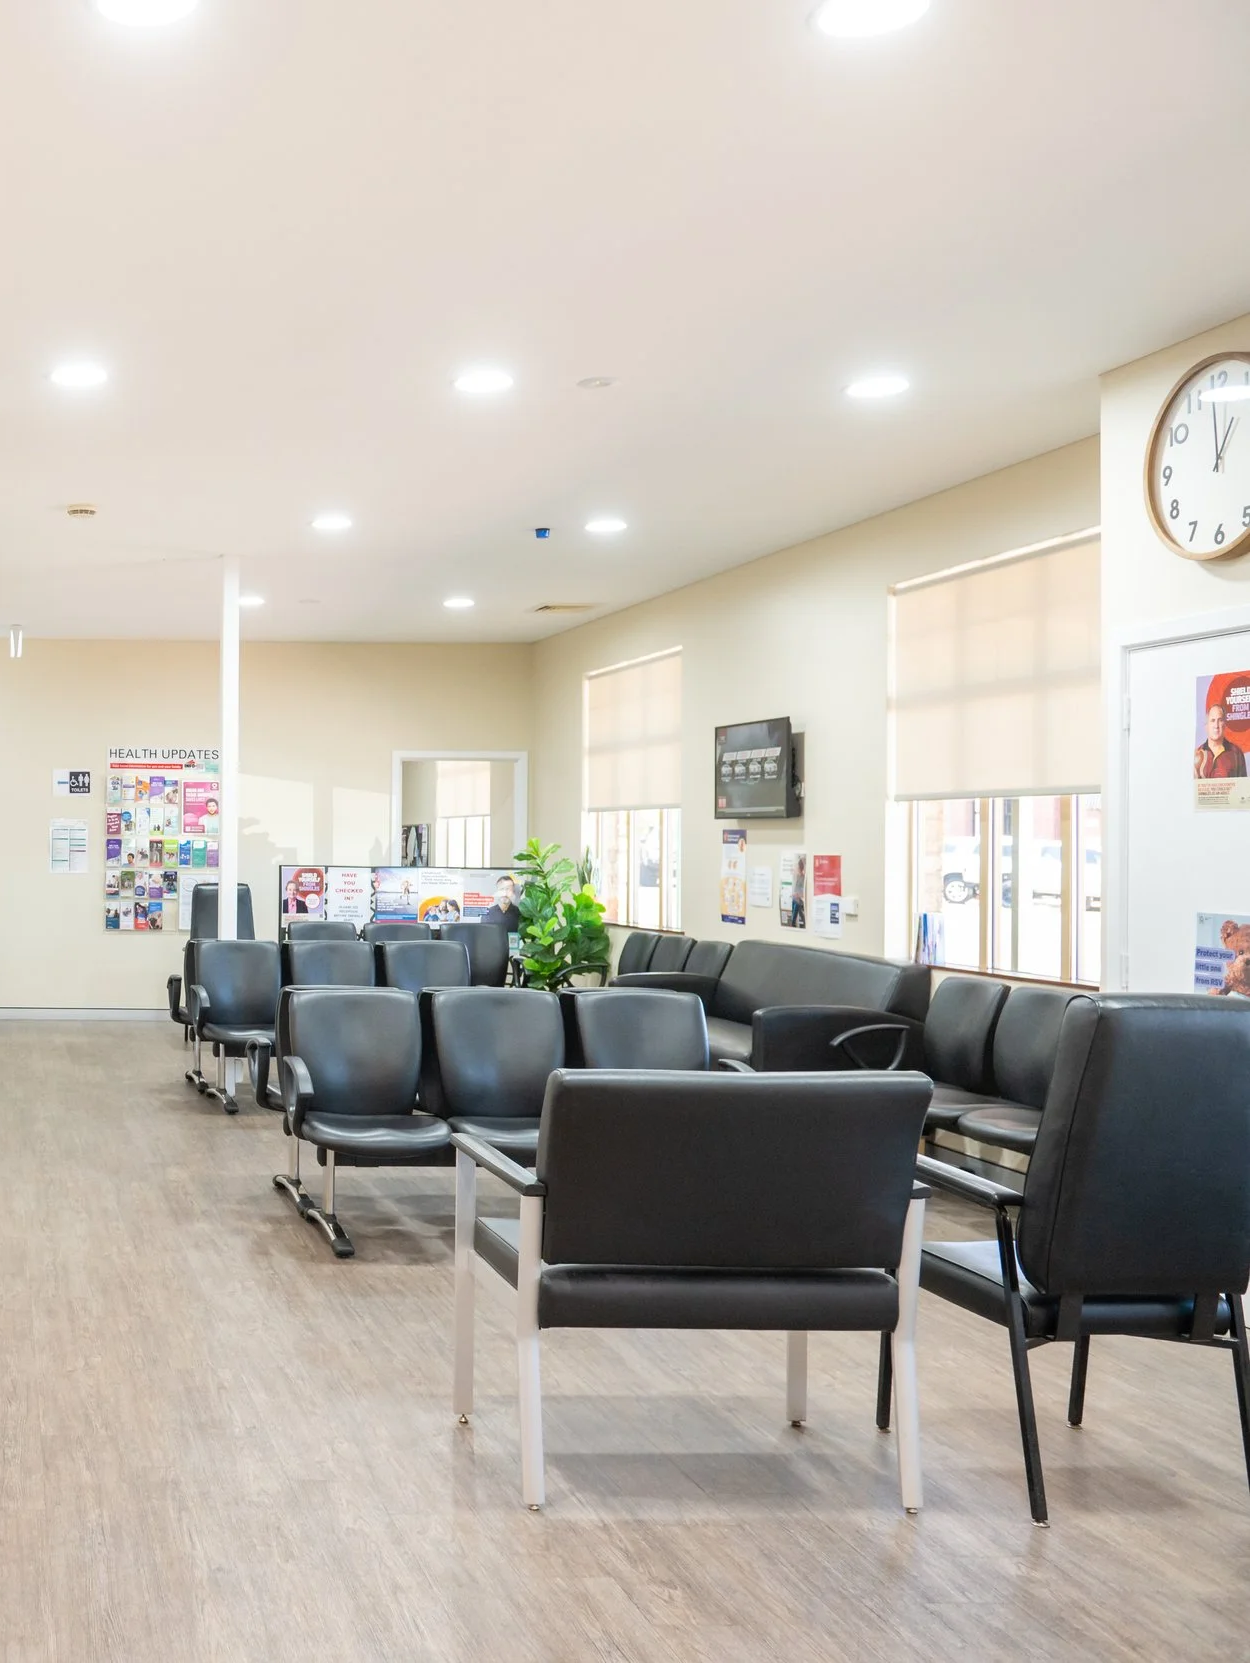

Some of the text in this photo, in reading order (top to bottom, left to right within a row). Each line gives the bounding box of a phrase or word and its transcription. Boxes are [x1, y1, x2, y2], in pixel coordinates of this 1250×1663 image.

[1187, 389, 1202, 414] 11
[1169, 423, 1189, 447] 10
[1162, 466, 1173, 486] 9
[1169, 499, 1180, 520] 8
[1188, 520, 1199, 542] 7
[1213, 523, 1225, 546] 6
[1225, 695, 1250, 705] YOURSE
[1232, 703, 1249, 712] FROM
[1226, 711, 1250, 721] SHINGLE
[109, 748, 219, 760] HEALTH UPDATES
[1196, 948, 1234, 960] Protect your
[1195, 962, 1209, 971] little
[1195, 976, 1223, 986] from RSV
